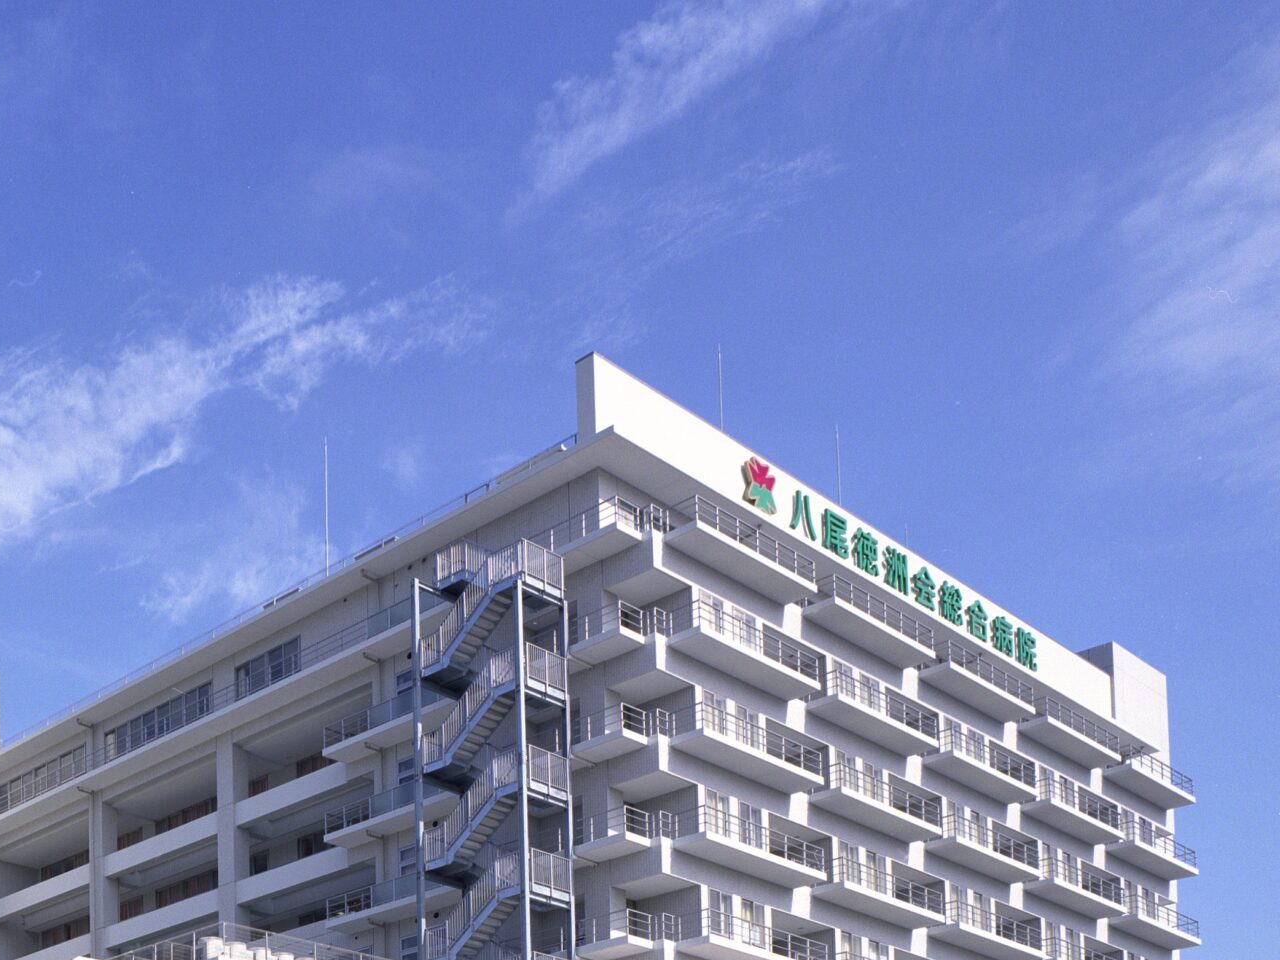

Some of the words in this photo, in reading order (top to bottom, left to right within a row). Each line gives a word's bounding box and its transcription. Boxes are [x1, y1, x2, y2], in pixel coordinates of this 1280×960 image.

[790, 490, 1038, 671] 八尾徳洲会総合病院
